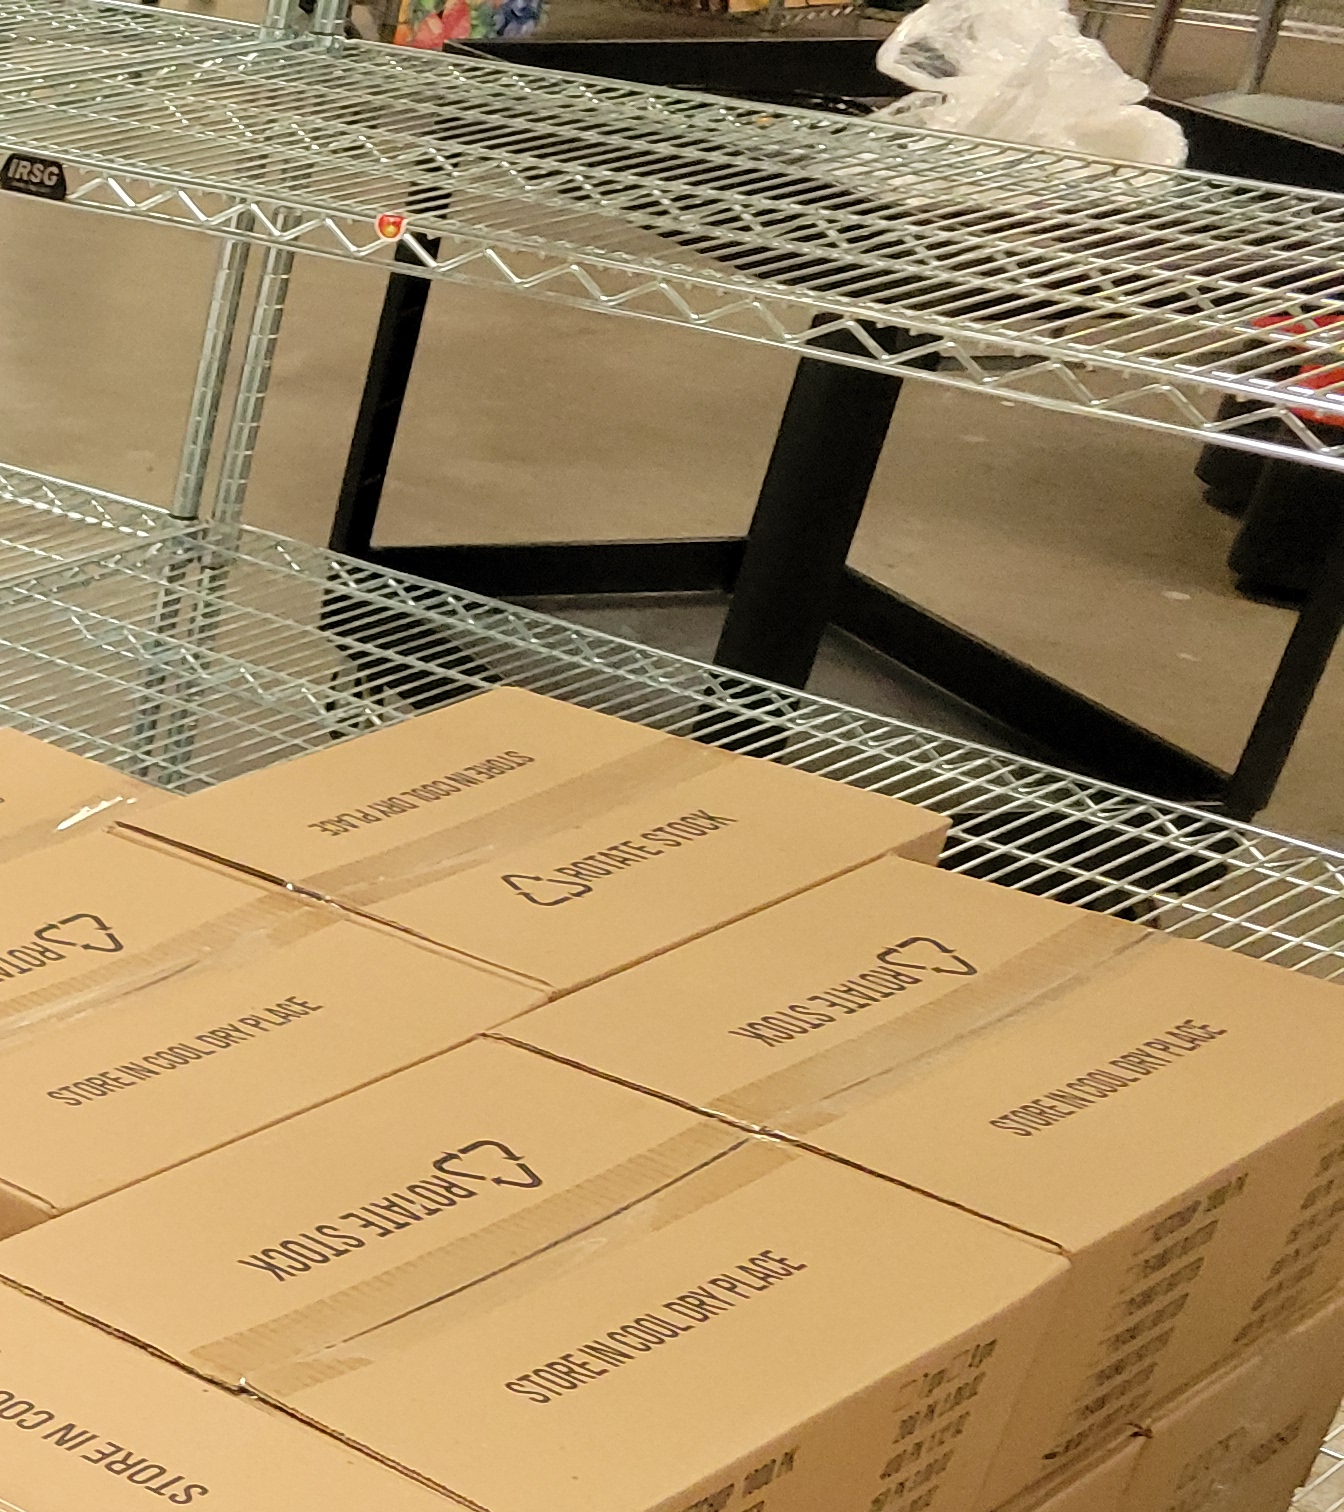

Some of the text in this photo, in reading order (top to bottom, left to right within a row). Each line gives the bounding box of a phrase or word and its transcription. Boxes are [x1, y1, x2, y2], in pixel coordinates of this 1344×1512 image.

[7, 158, 60, 187] IRSG
[307, 750, 536, 837] STORE IN COOL DRY PLACE
[552, 808, 738, 883] ROTATE STOCK
[727, 965, 924, 1047] ROTATE STOCK
[46, 995, 324, 1107] STORE IN COOL DRY PLACE
[988, 1019, 1228, 1137] STORE IN COOL DRY PLACE
[236, 1174, 480, 1283] ROTATE STOCK
[504, 1249, 808, 1404] STORE IN COOL DRY PLACE
[40, 1422, 100, 1452] IN
[79, 1441, 210, 1505] STORE
